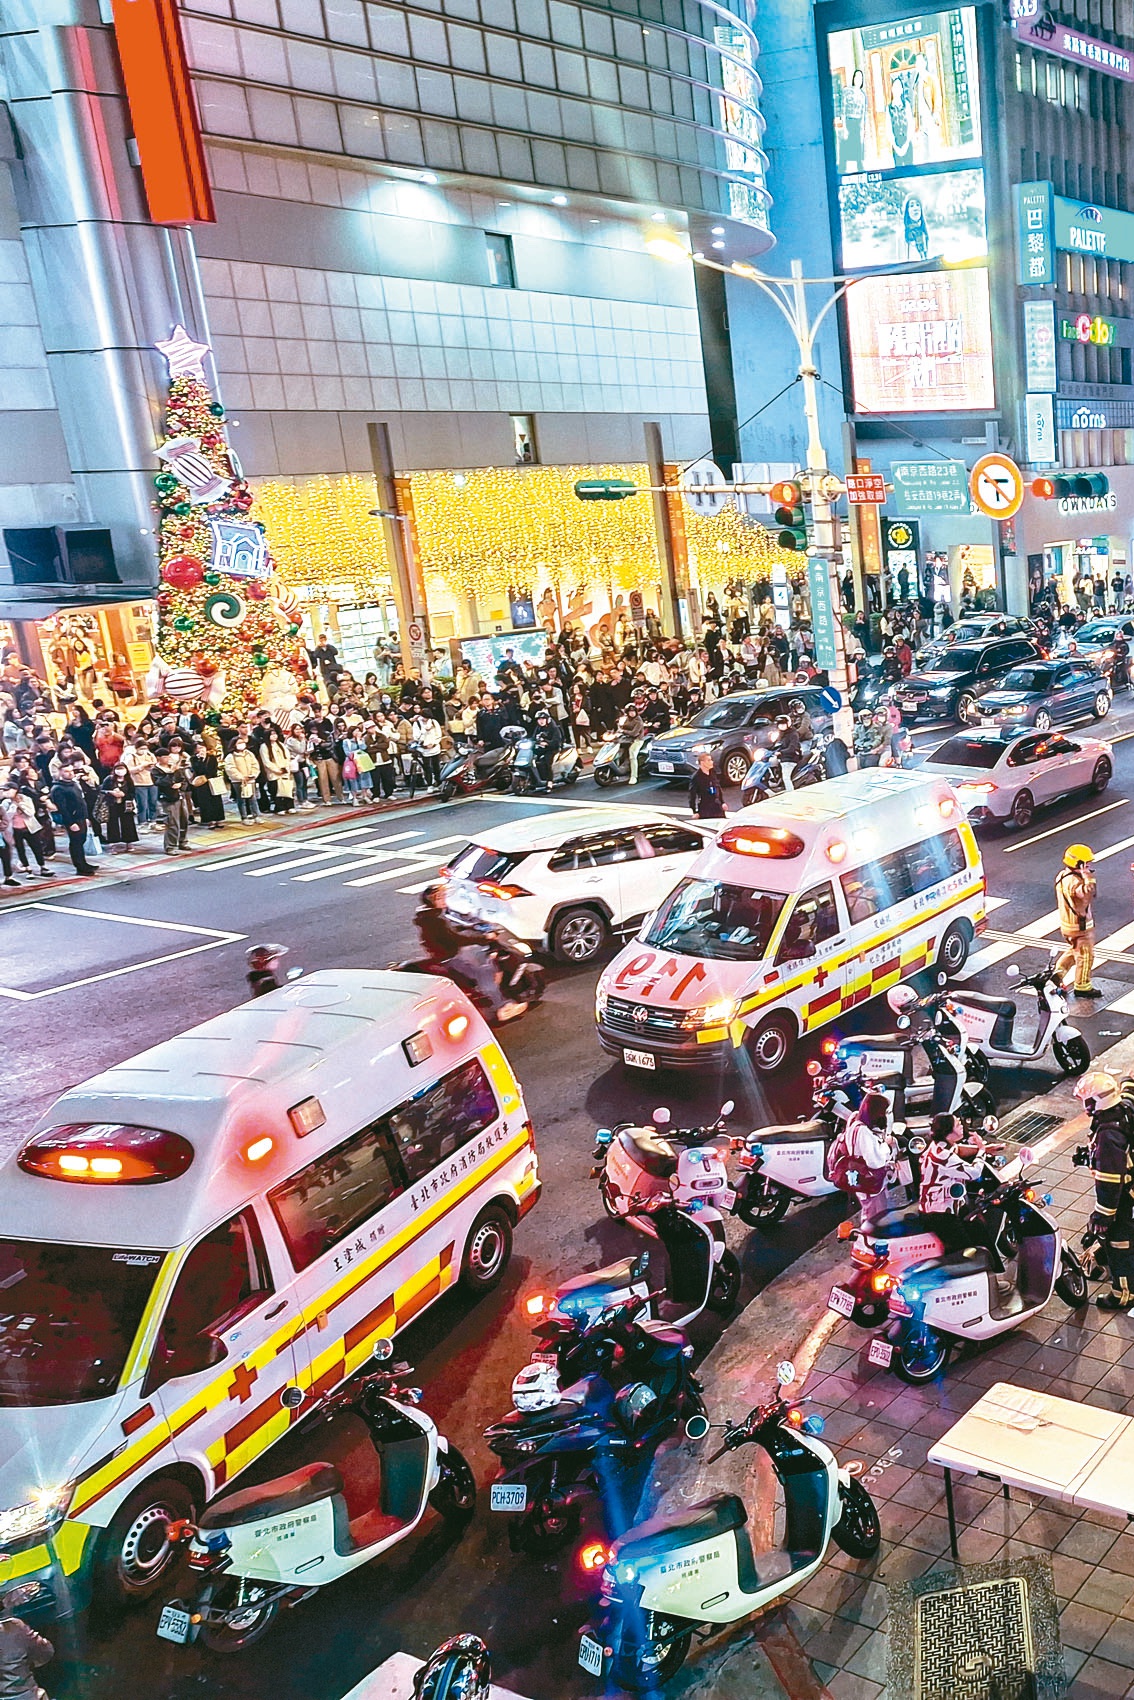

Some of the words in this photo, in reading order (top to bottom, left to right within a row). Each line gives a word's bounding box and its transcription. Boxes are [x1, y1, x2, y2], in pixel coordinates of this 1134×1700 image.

[1027, 208, 1046, 278] 巴黎都
[1069, 226, 1106, 253] PALETTE
[900, 465, 958, 477] 南京西路23巷
[847, 478, 883, 489] 路口淨空
[1061, 494, 1118, 512] OWNDAYS
